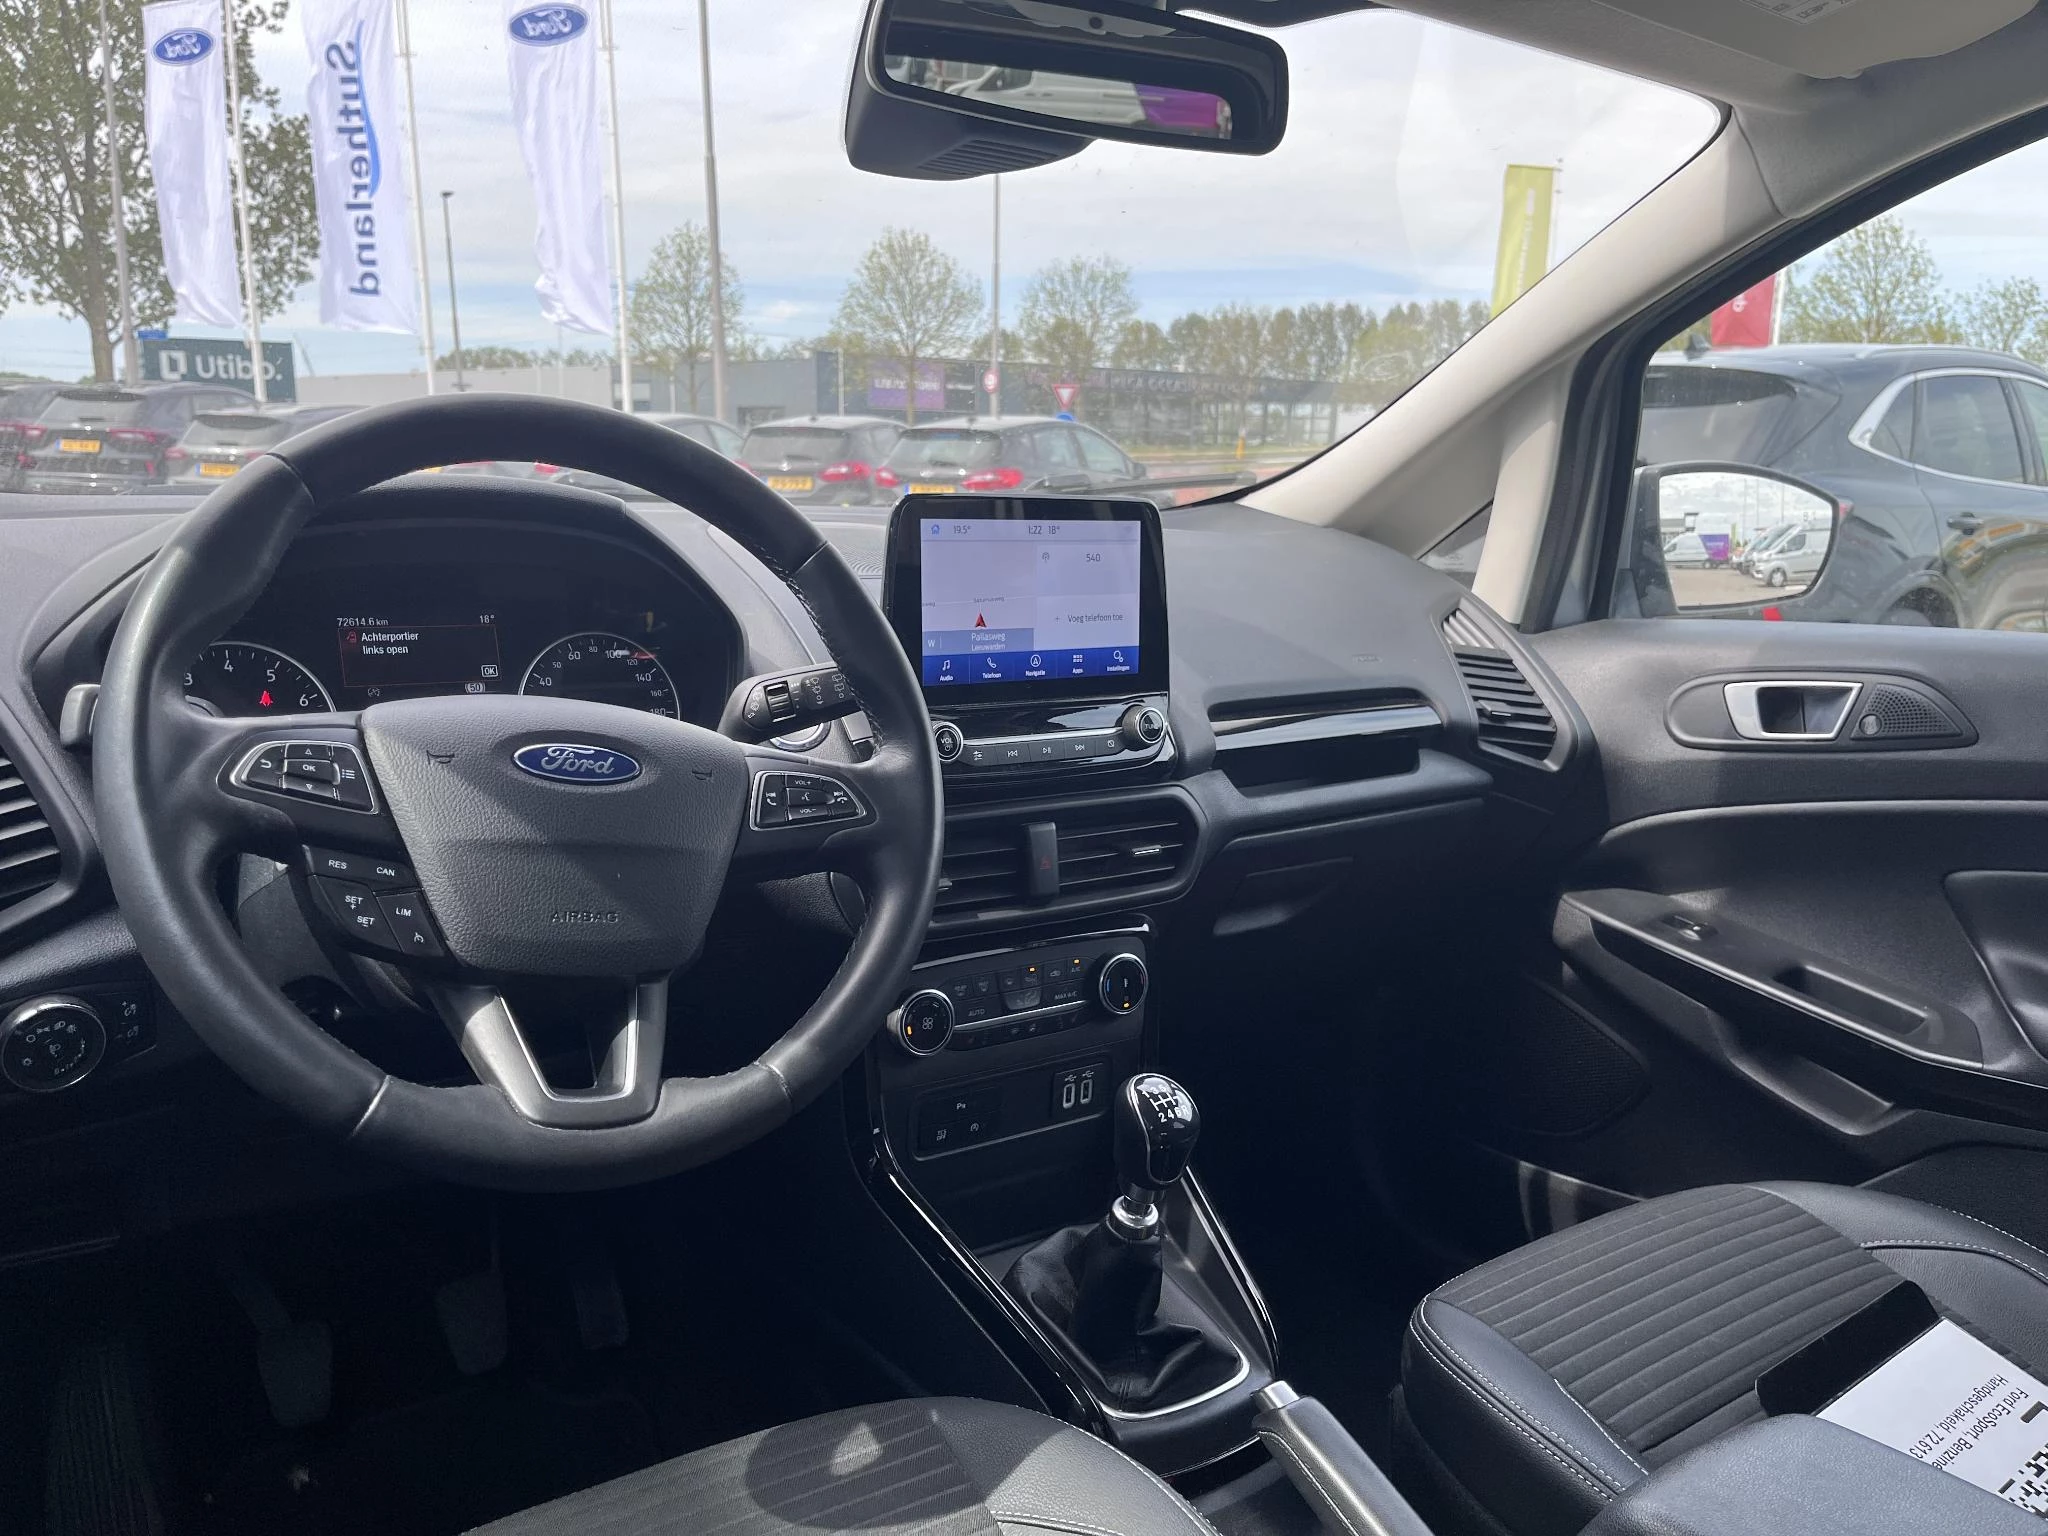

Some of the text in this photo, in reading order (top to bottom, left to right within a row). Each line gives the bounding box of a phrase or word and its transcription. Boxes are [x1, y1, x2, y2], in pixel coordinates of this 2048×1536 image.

[953, 525, 971, 534] 19.5°
[1086, 553, 1101, 562] 540
[337, 617, 388, 627] 72614.6 km
[1067, 613, 1124, 623] Voeg telefoon toe
[361, 631, 419, 643] Achterportier
[971, 632, 1006, 642] Pallasweg
[927, 639, 936, 648] W
[362, 646, 409, 656] links open
[567, 651, 581, 660] 60
[224, 660, 233, 673] 4
[552, 661, 561, 669] 50
[266, 669, 276, 682] 5
[483, 667, 496, 675] OK
[1025, 669, 1046, 677] Navigatie
[539, 676, 552, 687] 40
[635, 673, 651, 682] 140
[940, 674, 953, 682] Audio
[299, 694, 309, 707] 6
[541, 746, 615, 775] Ford
[302, 764, 316, 772] OK
[328, 859, 347, 870] RES
[376, 866, 395, 877] CAN
[344, 895, 363, 905] SET
[395, 907, 411, 917] LIM
[552, 911, 619, 923] AIRBAG
[357, 915, 375, 926] SET
[968, 1008, 985, 1017] AUTO
[1158, 1112, 1167, 1122] 2
[1167, 1108, 1175, 1119] 4
[1909, 1374, 2009, 1459] Handgeschakeld, 72.613
[1932, 1387, 2030, 1470] Ford EcoSport, Benzine
